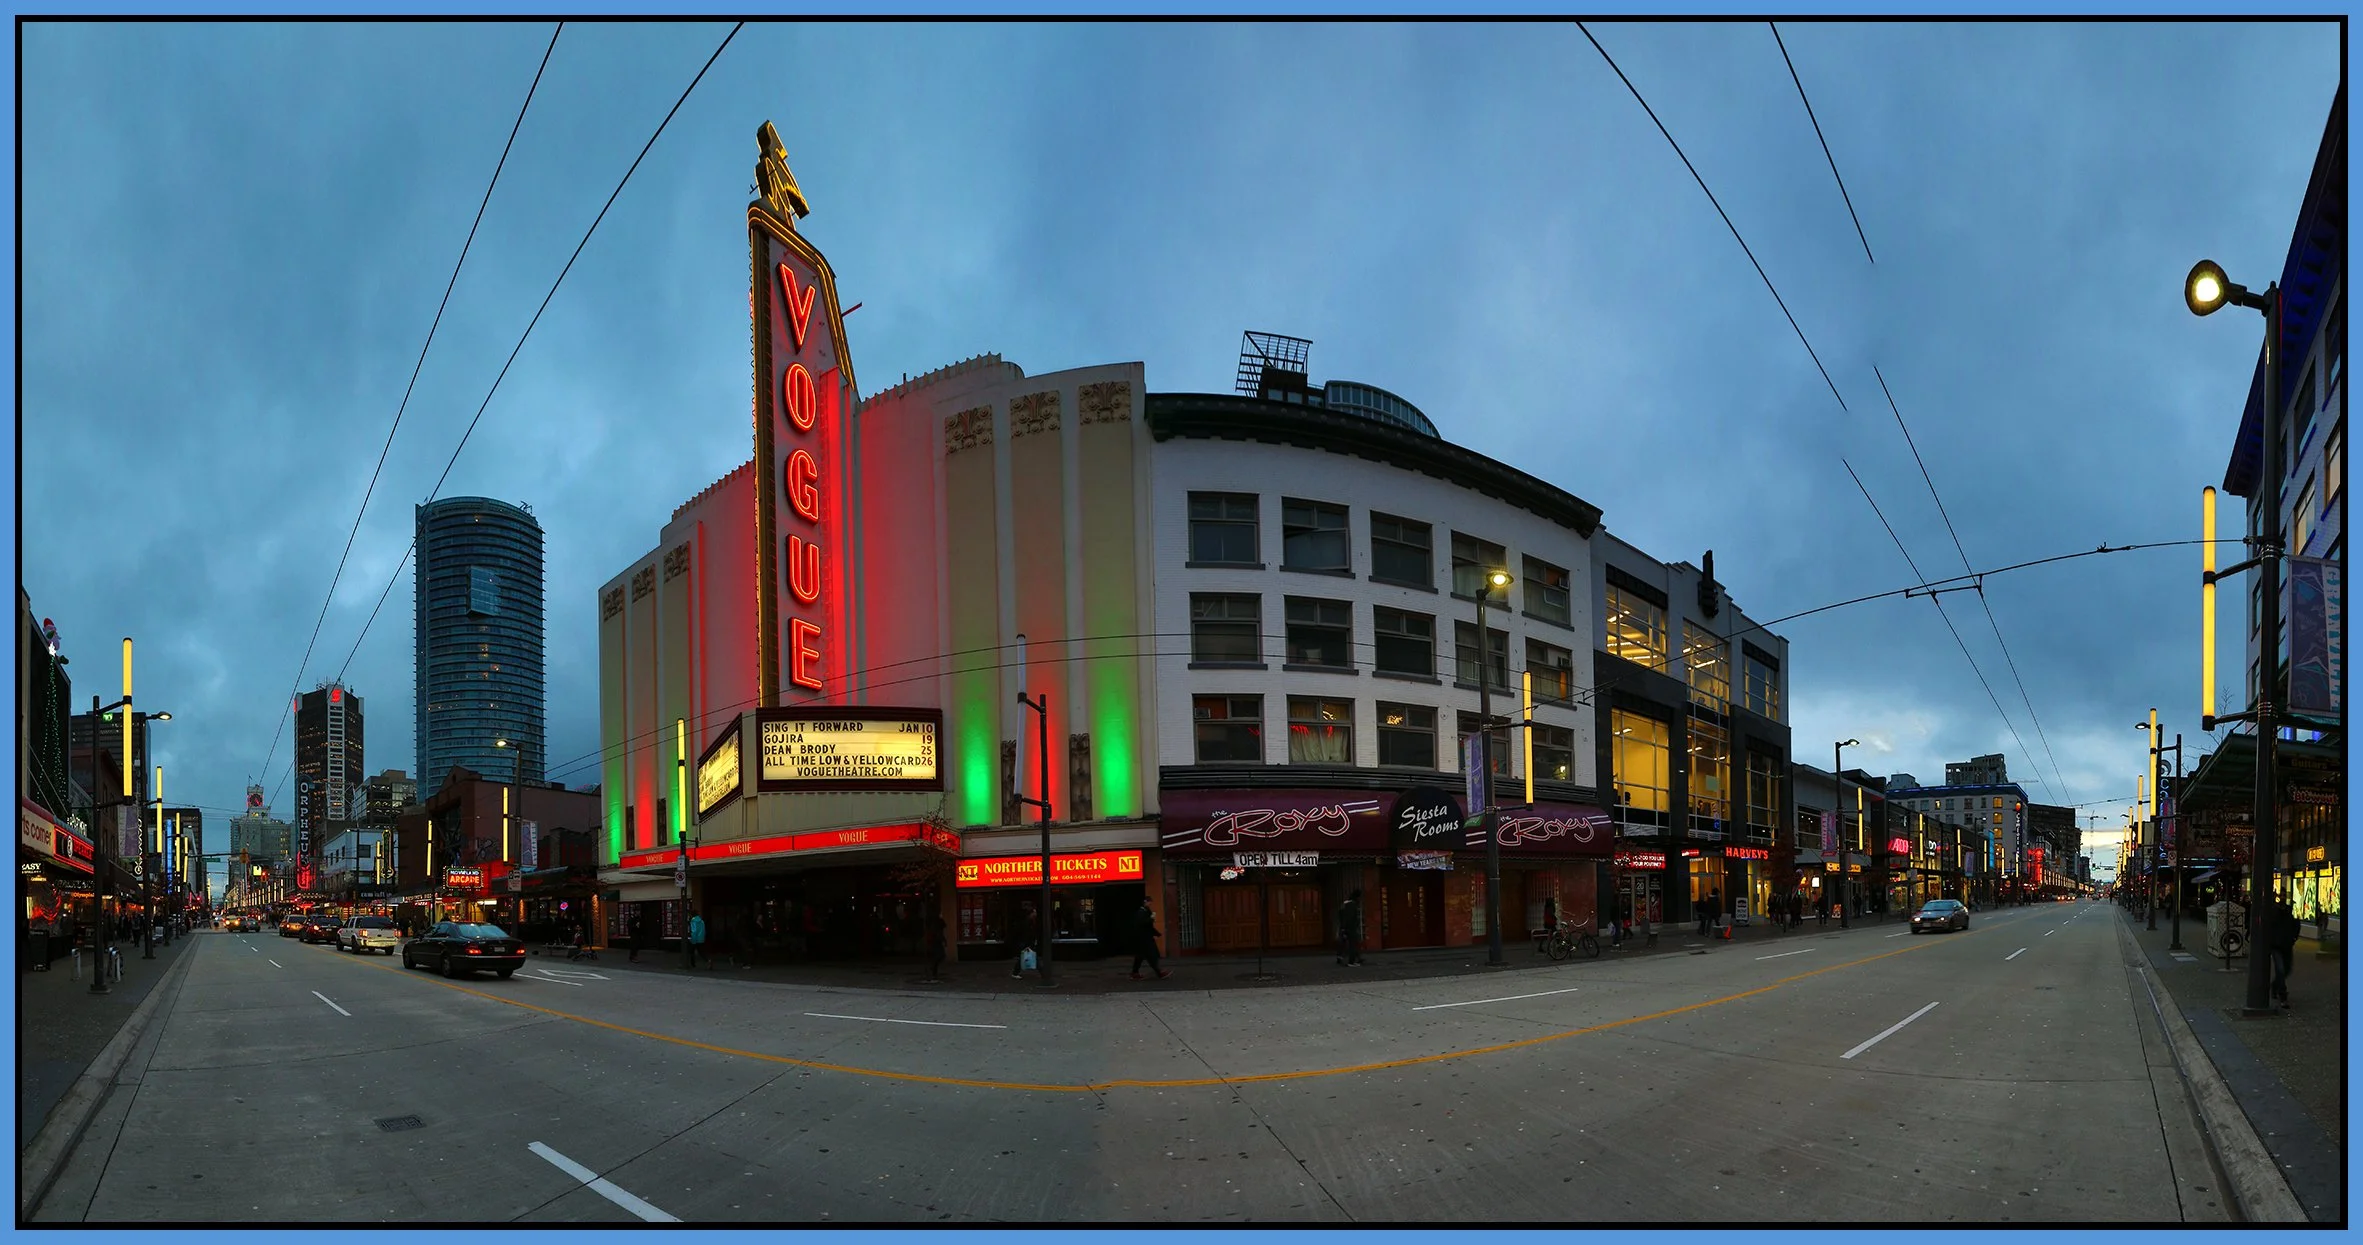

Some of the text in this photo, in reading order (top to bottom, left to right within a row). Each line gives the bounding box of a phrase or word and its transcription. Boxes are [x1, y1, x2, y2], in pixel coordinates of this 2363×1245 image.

[777, 262, 824, 692] VOGUE
[764, 722, 933, 733] SING IT FORWARD JAN 10
[764, 734, 933, 744] GOJIRA 19
[764, 744, 932, 755] DEAN BRODY 25
[765, 756, 785, 767] ALL
[790, 755, 816, 766] TIME
[921, 756, 933, 766] 26
[797, 766, 903, 777] VOGUETHEATRE.COM
[1399, 804, 1448, 829] Siesta
[300, 782, 309, 865] ORPHEU
[1204, 804, 1351, 846] Roxy
[839, 830, 868, 843] VOGUE
[1413, 819, 1459, 842] Rooms
[1496, 816, 1595, 846] Roxy
[729, 843, 752, 854] VOGUE
[1725, 846, 1769, 860] HARVEY'S
[645, 853, 664, 864] VOGUE
[1054, 858, 1107, 871] TICKETS
[1120, 857, 1139, 870] NT
[1239, 853, 1318, 866] OPEN TILL 4am
[449, 875, 480, 884] ARCADE
